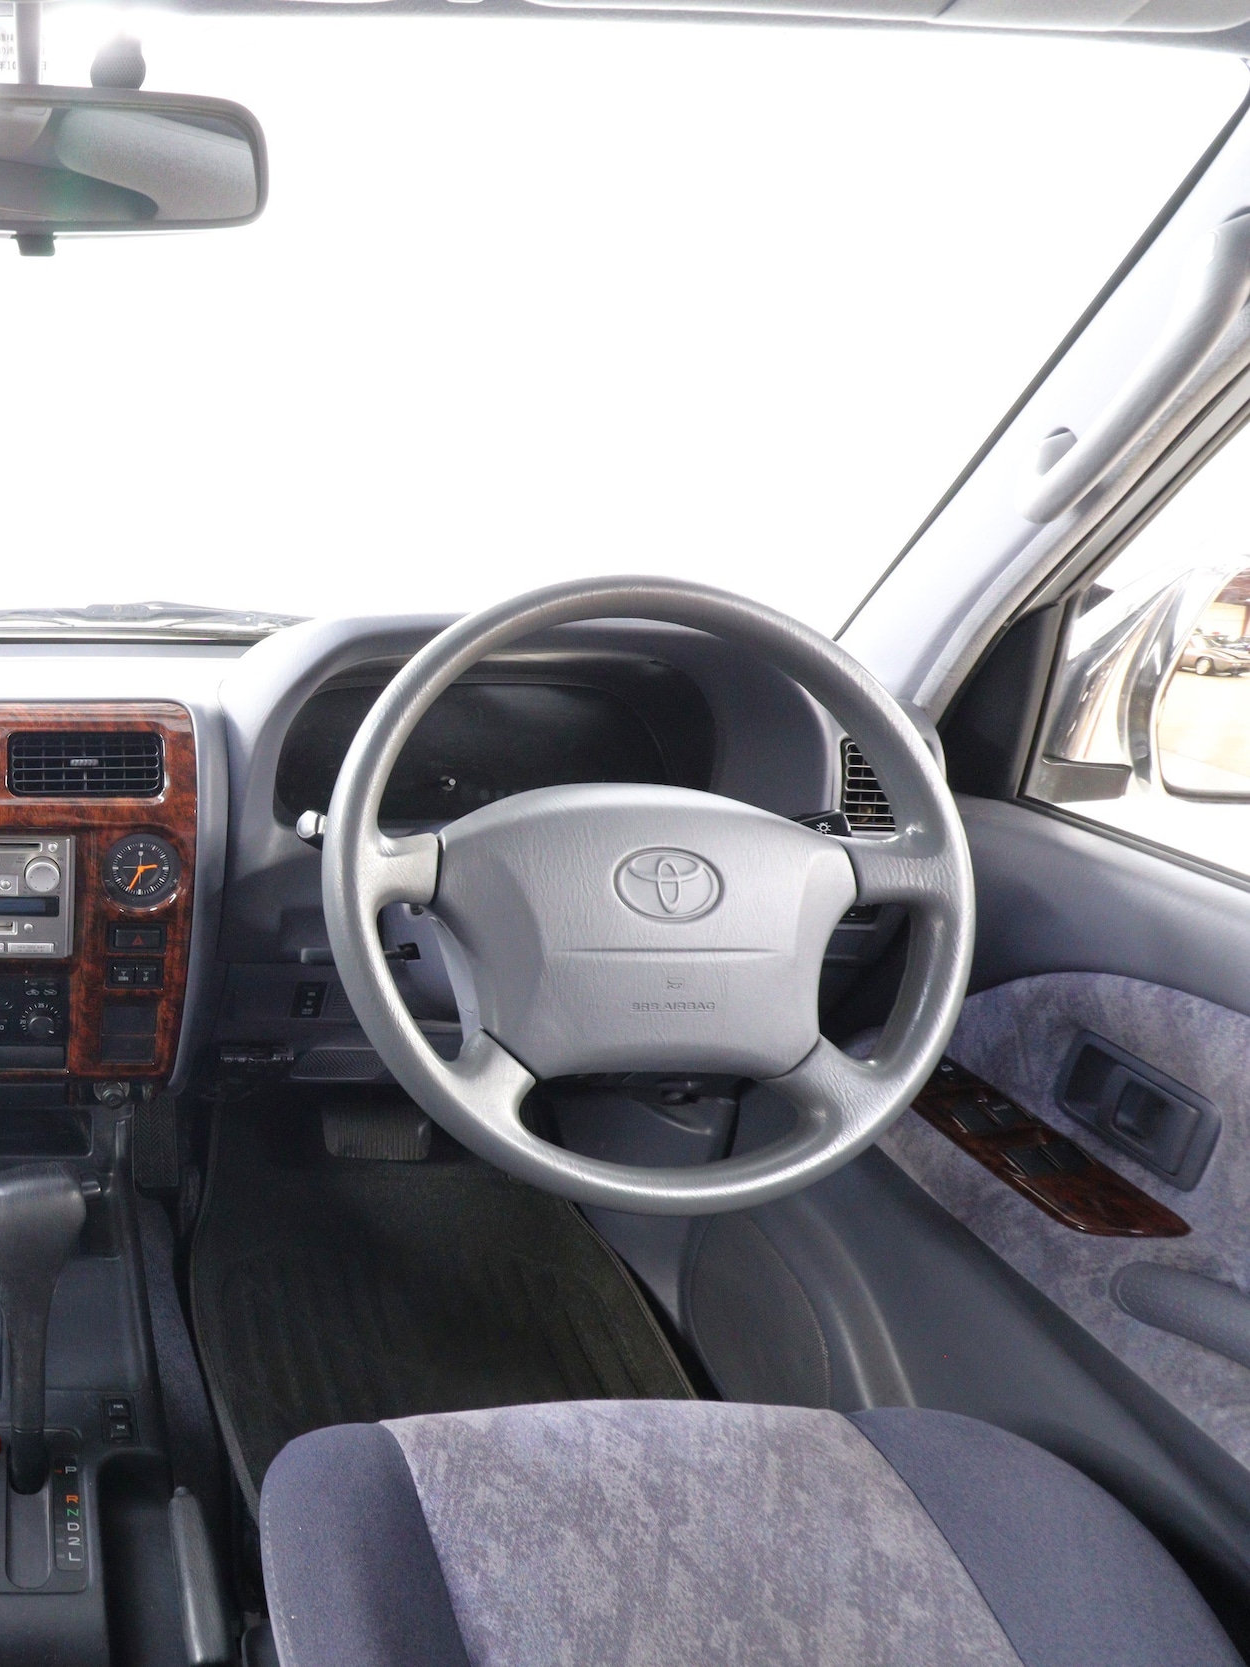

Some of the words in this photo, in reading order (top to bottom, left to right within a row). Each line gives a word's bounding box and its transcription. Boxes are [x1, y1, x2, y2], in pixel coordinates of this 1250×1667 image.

[631, 1002, 659, 1011] SRS
[664, 1001, 716, 1011] AIRBAG
[65, 1466, 77, 1474] P
[66, 1495, 79, 1504] R
[67, 1509, 79, 1517] N
[67, 1522, 80, 1532] D
[68, 1536, 81, 1546] 2
[68, 1552, 81, 1562] L
